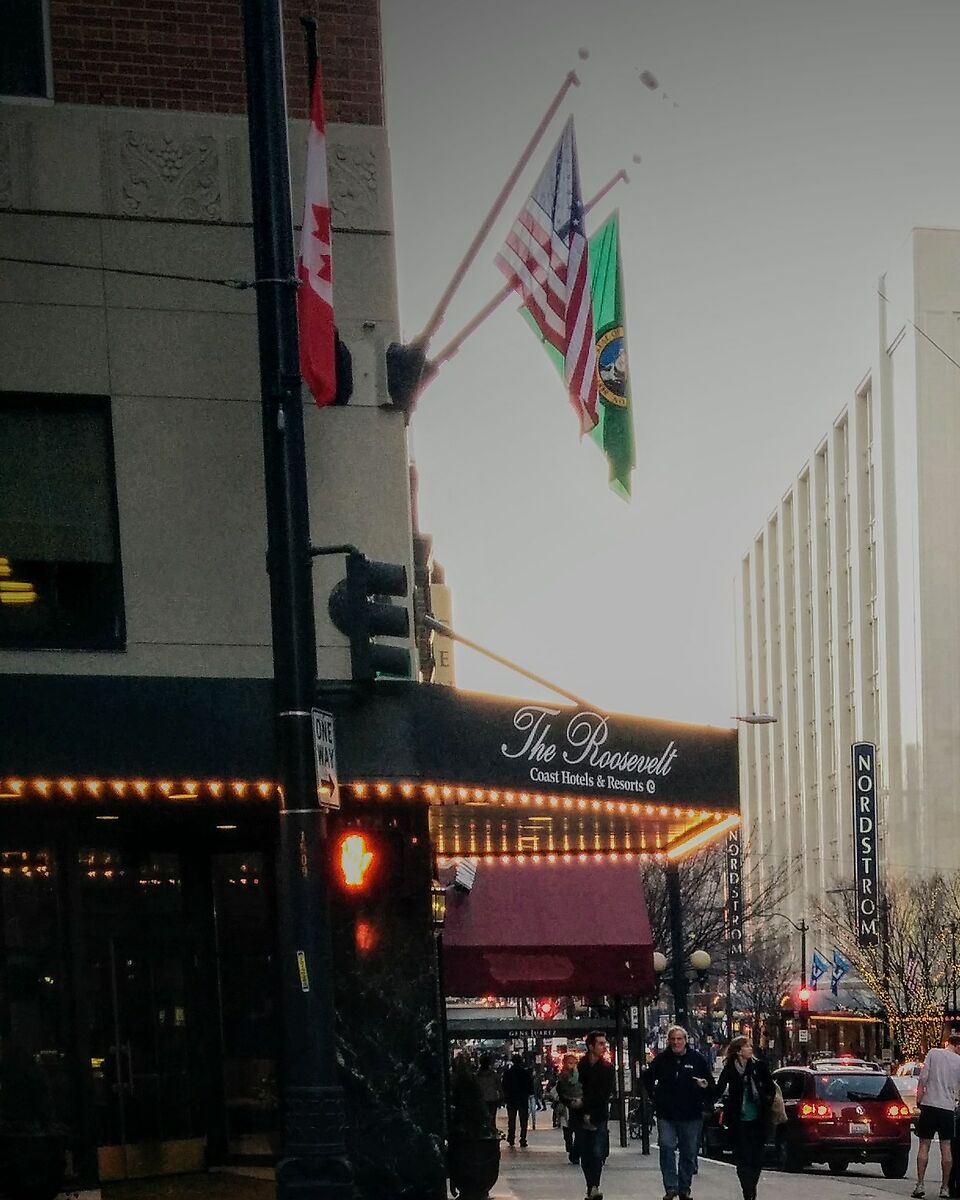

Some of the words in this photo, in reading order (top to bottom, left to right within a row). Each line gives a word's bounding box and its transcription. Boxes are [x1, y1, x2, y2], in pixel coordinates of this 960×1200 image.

[316, 718, 333, 744] ONE
[501, 705, 561, 763] The
[563, 711, 678, 776] Roosevelt
[318, 745, 334, 769] WAY
[530, 767, 560, 784] Coast
[561, 770, 594, 787] Hotels
[596, 774, 606, 788] &
[607, 776, 644, 792] Resorts
[858, 754, 877, 936] NORDSTROM
[728, 830, 742, 954] NORDSTROM
